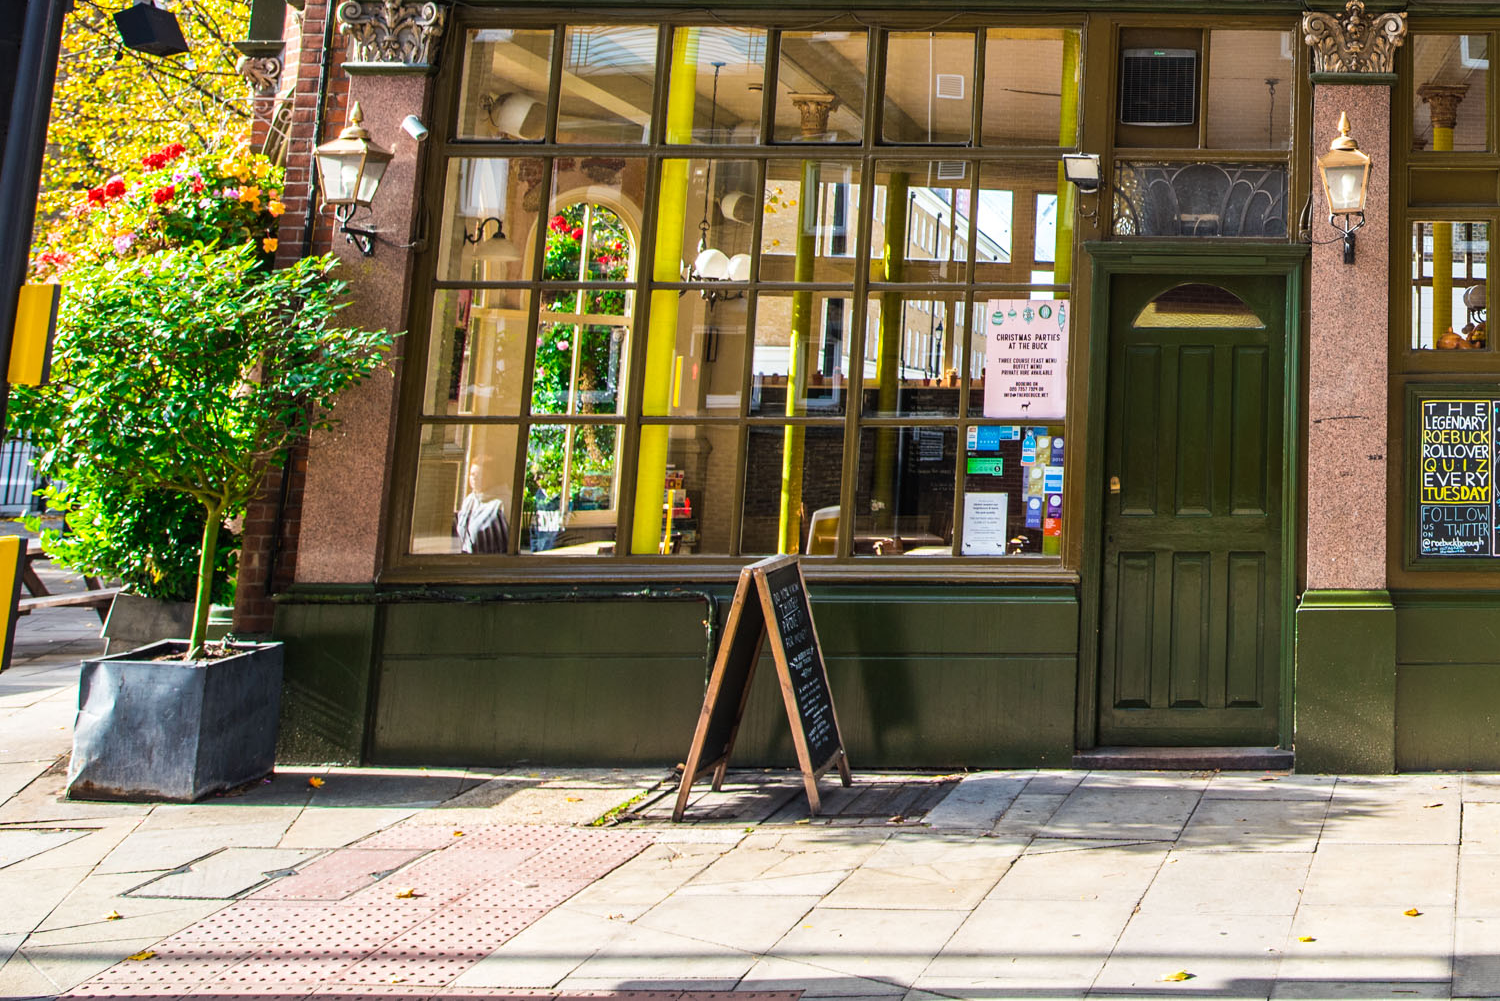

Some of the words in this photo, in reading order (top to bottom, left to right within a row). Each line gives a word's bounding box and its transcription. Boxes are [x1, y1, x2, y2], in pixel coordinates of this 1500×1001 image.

[996, 333, 1032, 341] CHRISTMAS
[1035, 333, 1061, 341] PARTIES
[1008, 342, 1016, 350] AT
[1019, 342, 1030, 350] THE
[1031, 342, 1048, 350] BUCK
[1424, 402, 1486, 416] THE
[1425, 416, 1488, 430] LEGENDARY
[1423, 430, 1489, 444] ROEBUCK
[1423, 444, 1489, 458] ROLLOVER
[1424, 458, 1488, 472] QUIZ
[1424, 472, 1489, 487] EVERY
[1423, 485, 1489, 501] TUESDAY
[1422, 506, 1488, 522] FOLLOW
[1443, 523, 1489, 537] TWITTER
[1422, 536, 1485, 552] @roebuckborough
